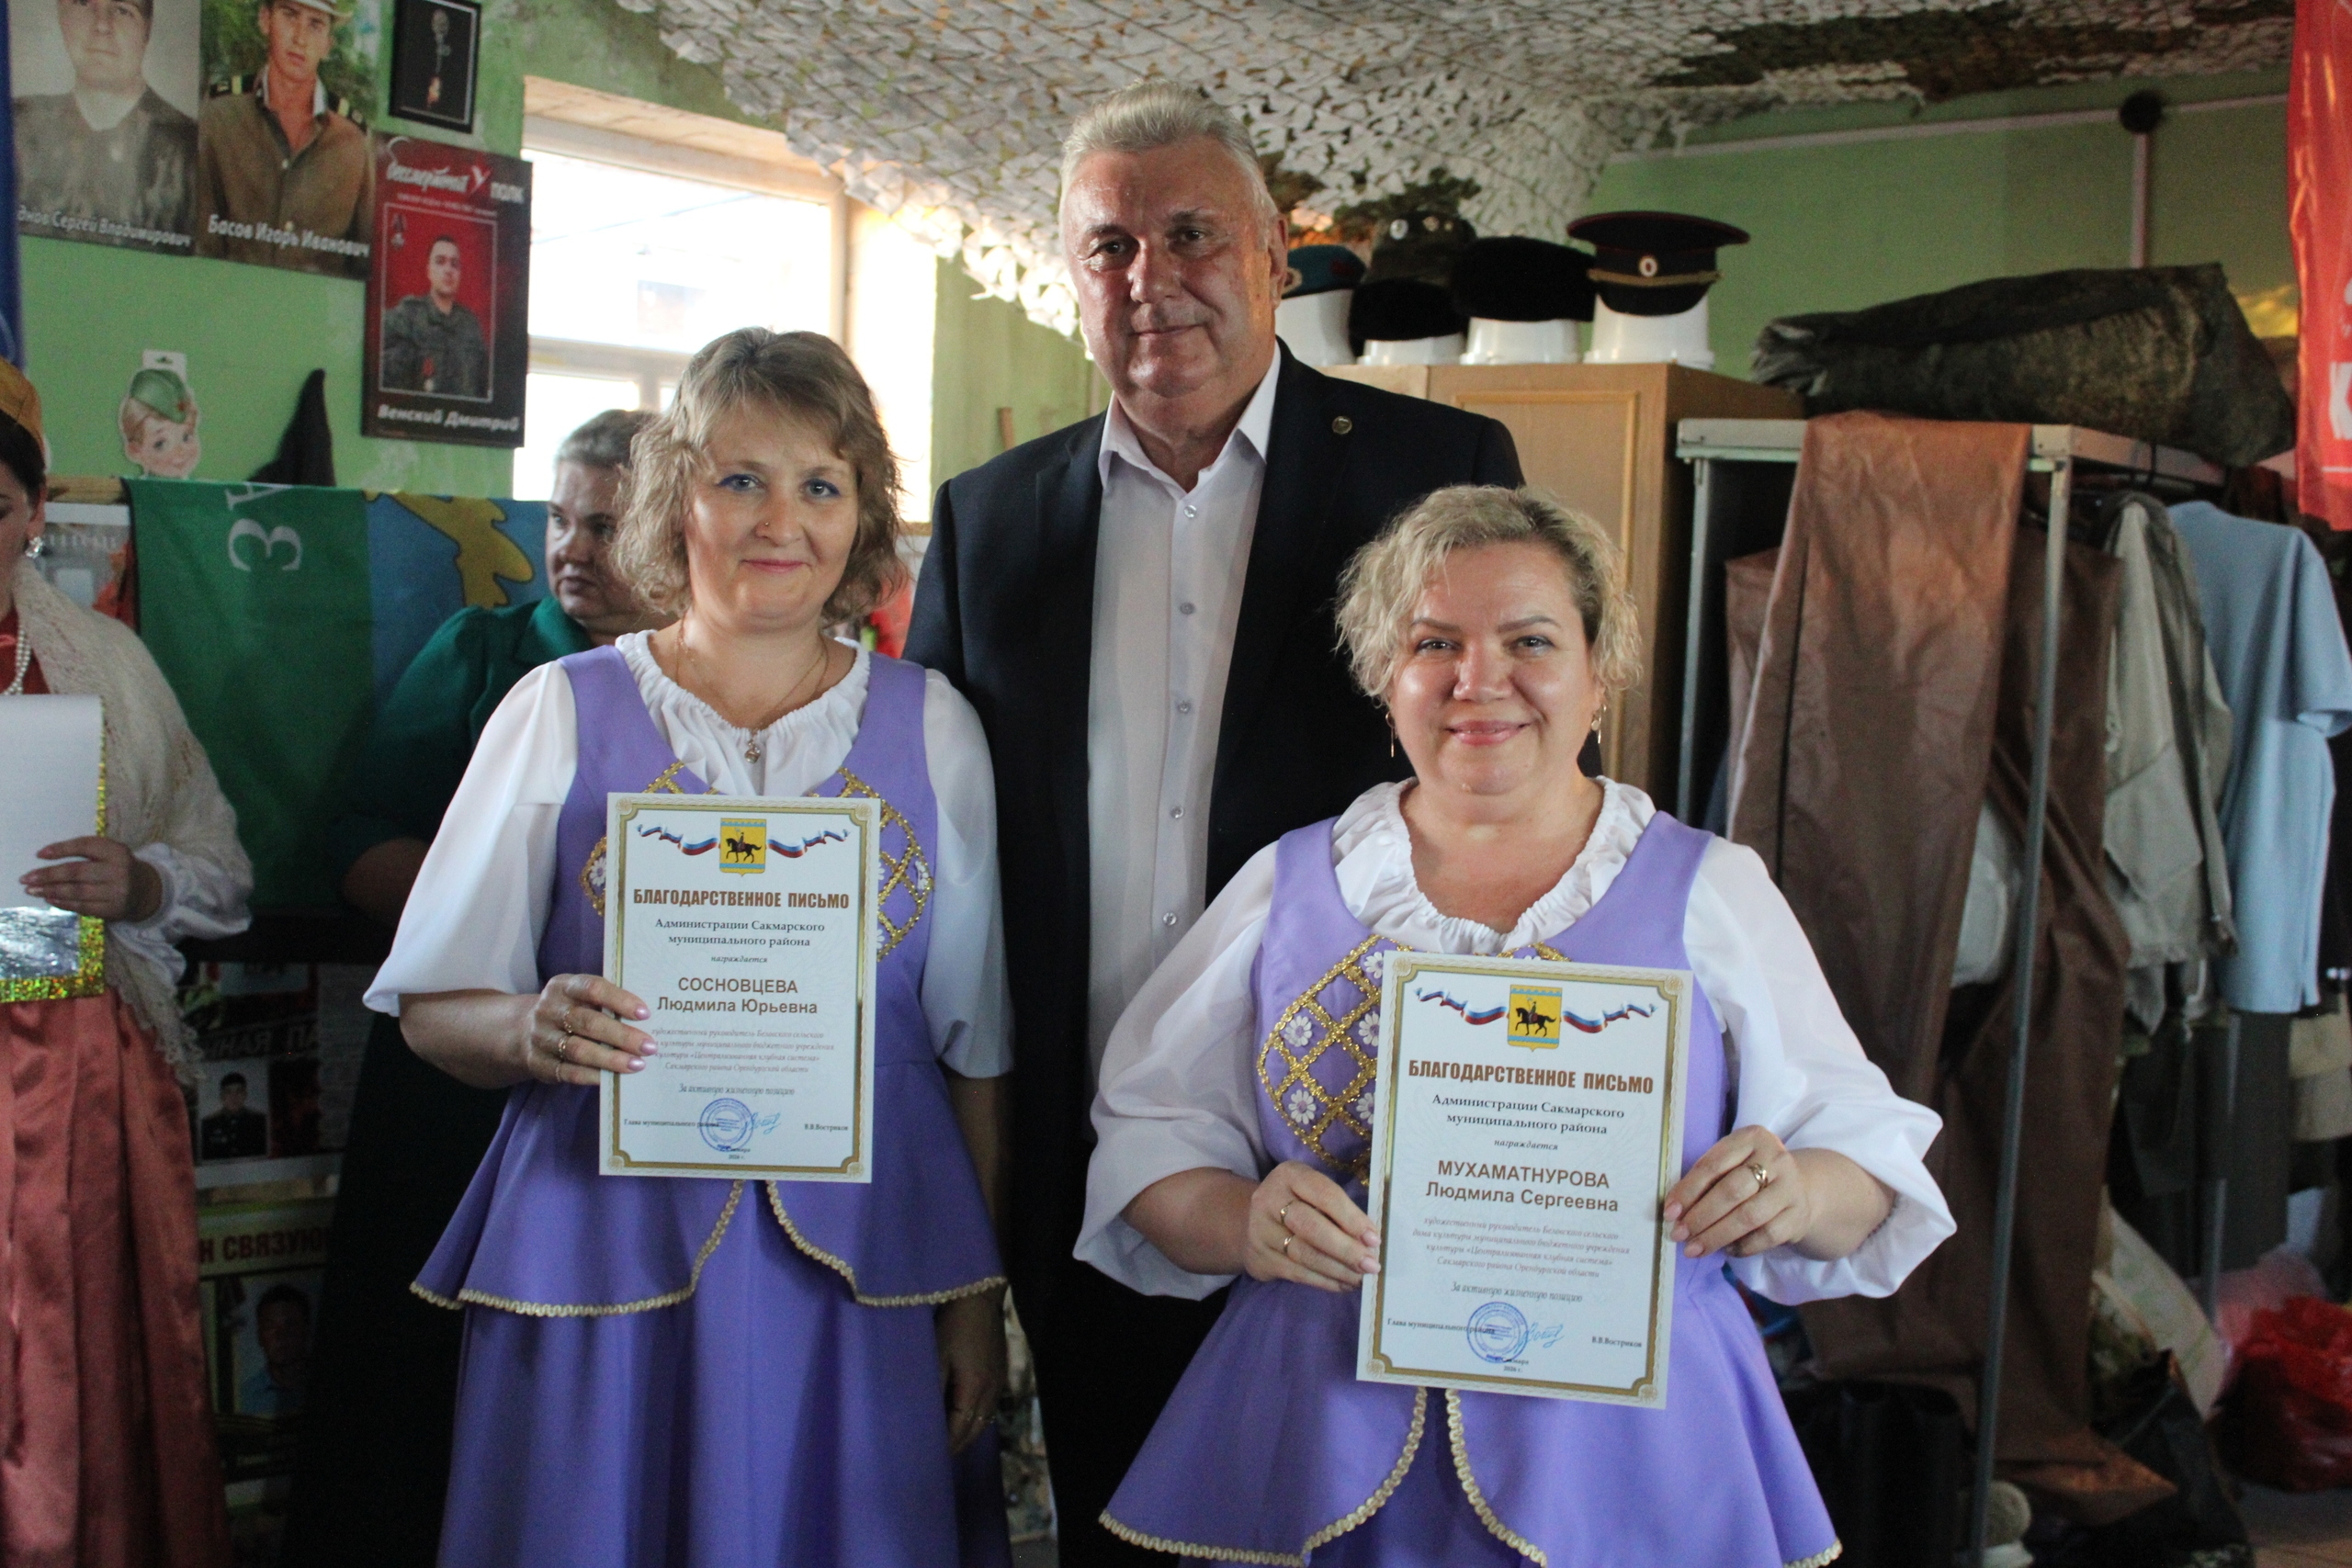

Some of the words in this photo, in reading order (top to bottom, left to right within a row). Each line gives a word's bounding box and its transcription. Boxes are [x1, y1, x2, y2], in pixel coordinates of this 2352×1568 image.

[208, 214, 253, 239] Басов
[254, 221, 300, 249] Игорь
[300, 229, 370, 257] Иванович
[634, 888, 782, 908] БЛАГОДАРСТВЕННОЕ
[787, 892, 850, 909] ПИСЬМО
[655, 919, 749, 931] Администрации
[752, 920, 825, 932] Сакмарского
[668, 936, 766, 947] муниципального
[769, 937, 810, 948] района
[710, 955, 768, 964] награждается
[678, 976, 798, 995] СОСНОВЦЕВА
[658, 997, 736, 1012] Людмила
[741, 998, 818, 1016] Юрьевна
[1408, 1060, 1576, 1089] БЛАГОДАРСТВЕННОЕ
[1583, 1072, 1654, 1094] ПИСЬМО
[1431, 1094, 1537, 1112] Администрации
[1541, 1102, 1625, 1119] Сакмарского
[1446, 1114, 1557, 1133] муниципального
[1561, 1121, 1608, 1135] района
[1494, 1139, 1558, 1151] награждается
[1438, 1160, 1610, 1189] МУХАМАТНУРОВА
[1426, 1182, 1515, 1204] Людмила
[1521, 1190, 1619, 1212] Сергеевна
[1412, 1228, 1431, 1237] дома
[1451, 1281, 1461, 1292] За
[1387, 1318, 1407, 1326] Глава
